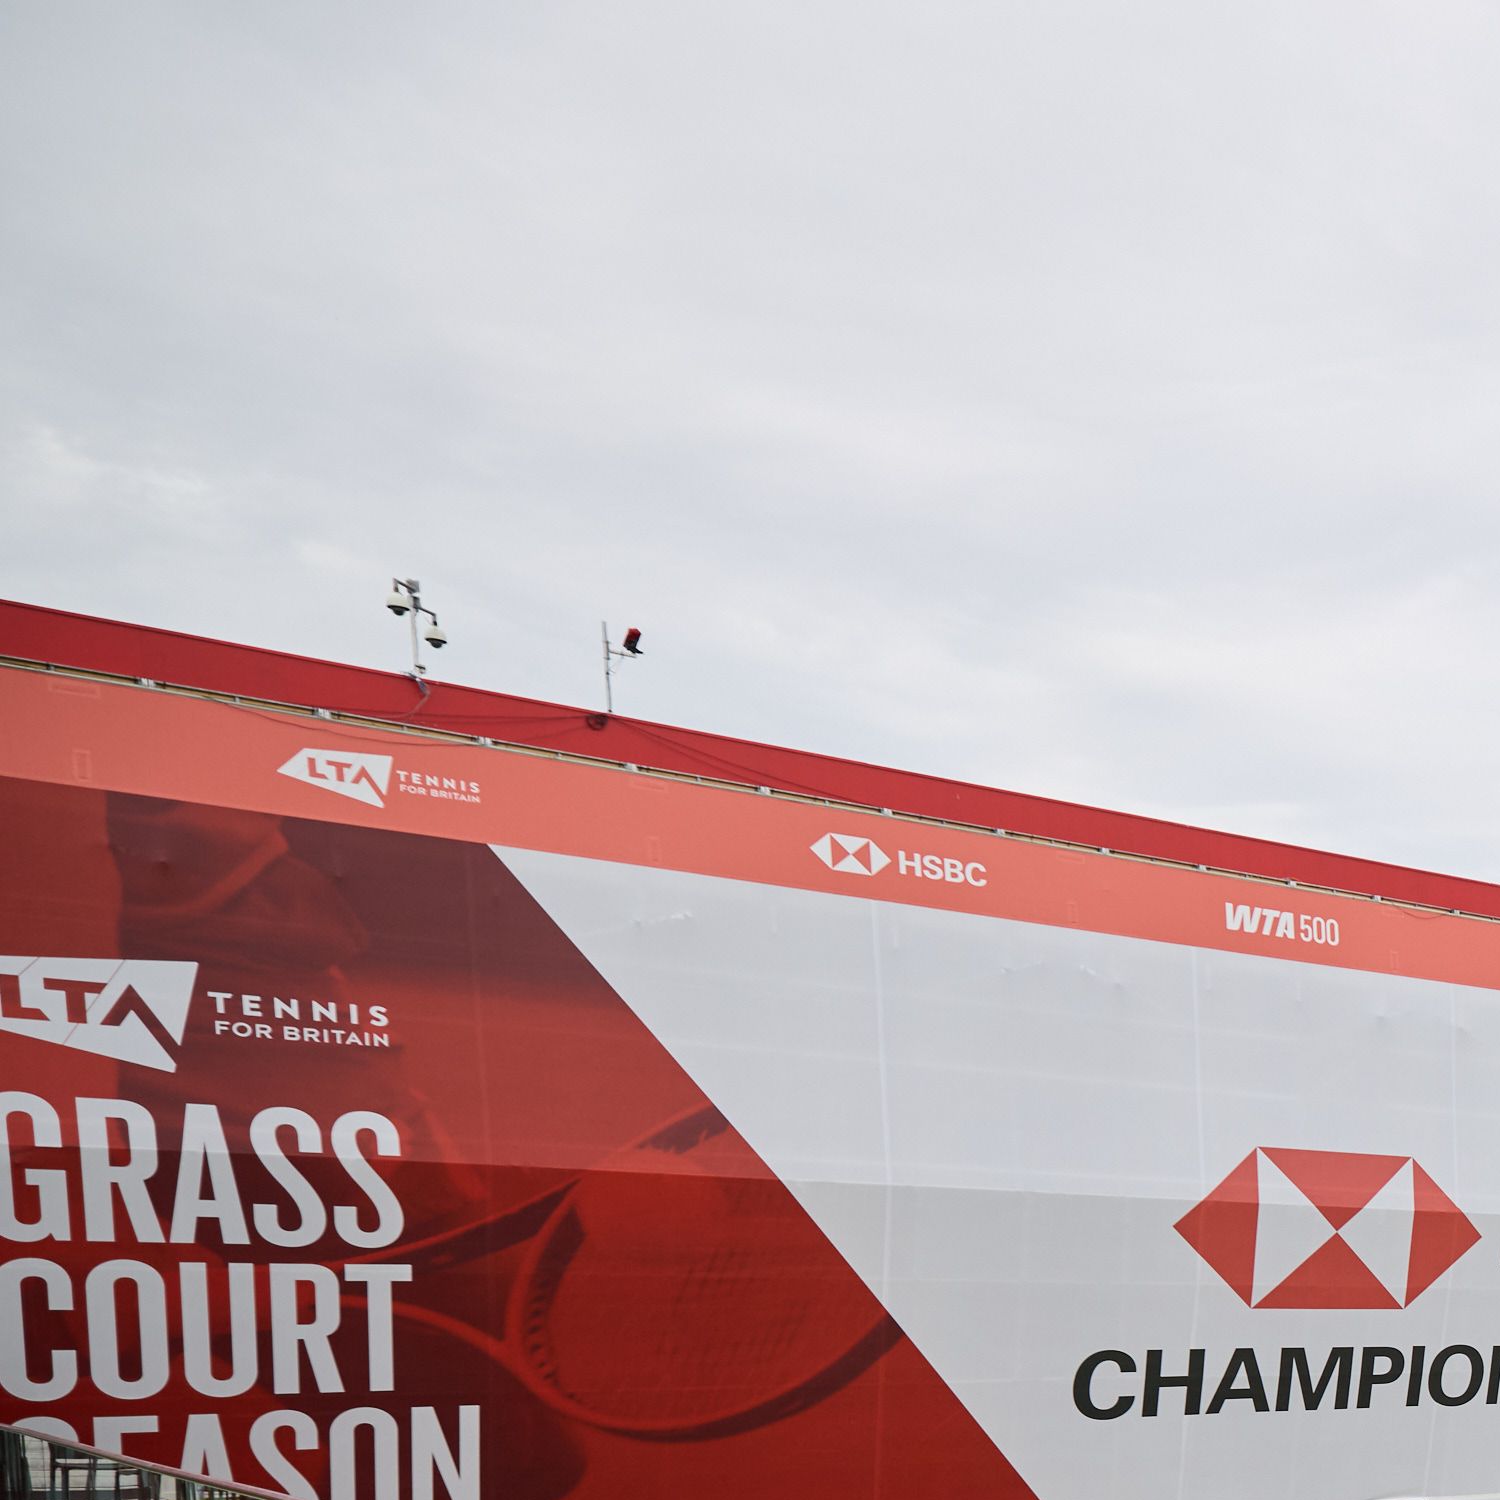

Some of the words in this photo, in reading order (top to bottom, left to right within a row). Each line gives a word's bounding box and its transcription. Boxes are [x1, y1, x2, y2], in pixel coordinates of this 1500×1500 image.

[306, 756, 387, 796] LTA
[396, 770, 480, 793] TENNIS
[400, 783, 427, 796] FOR
[431, 789, 481, 803] BRITAIN
[898, 849, 988, 887] HSBC
[1224, 901, 1296, 940] WTA
[1300, 914, 1340, 947] 500
[207, 991, 390, 1028] TENNIS
[214, 1020, 273, 1040] FOR
[283, 1026, 390, 1048] BRITAIN
[0, 1090, 406, 1250] GRASS
[0, 1257, 412, 1402] COURT
